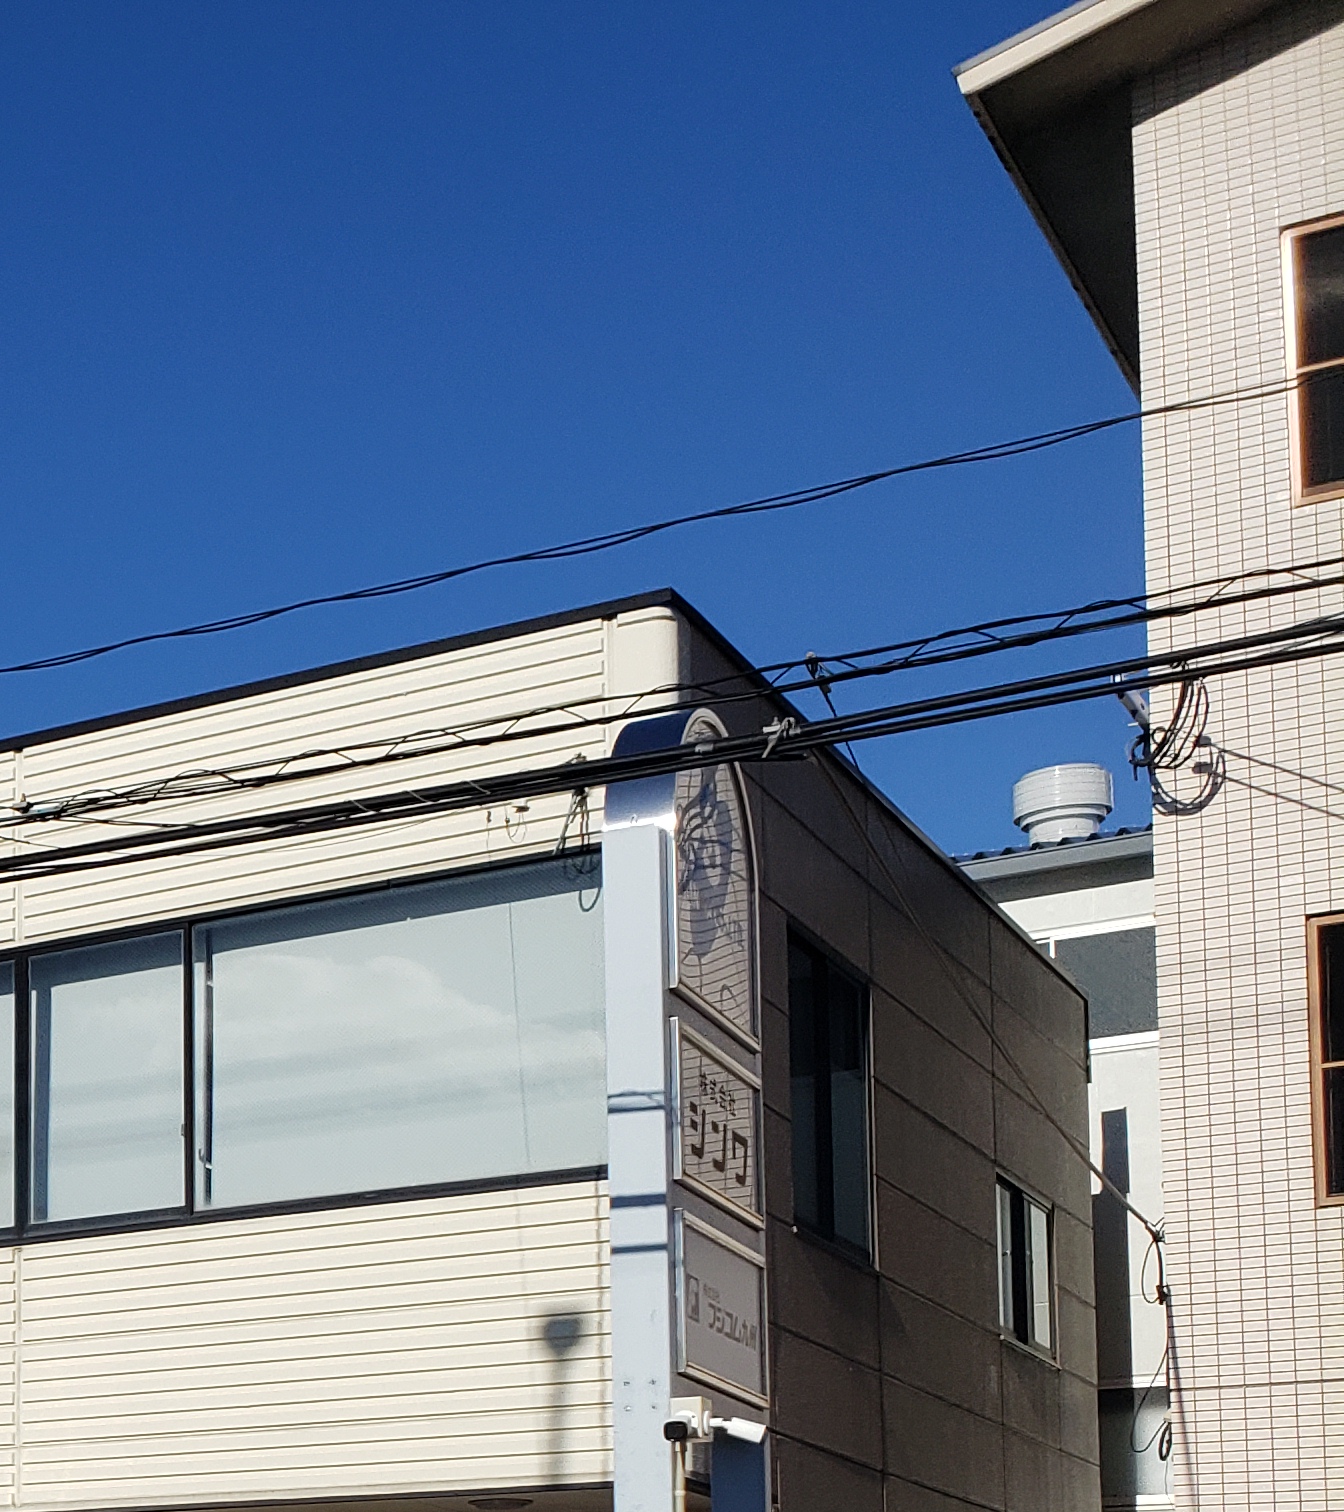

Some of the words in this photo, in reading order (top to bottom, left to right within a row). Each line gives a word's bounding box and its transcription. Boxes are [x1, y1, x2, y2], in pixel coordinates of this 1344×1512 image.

[699, 1071, 736, 1117] 株式会社
[689, 1100, 748, 1187] シンワ
